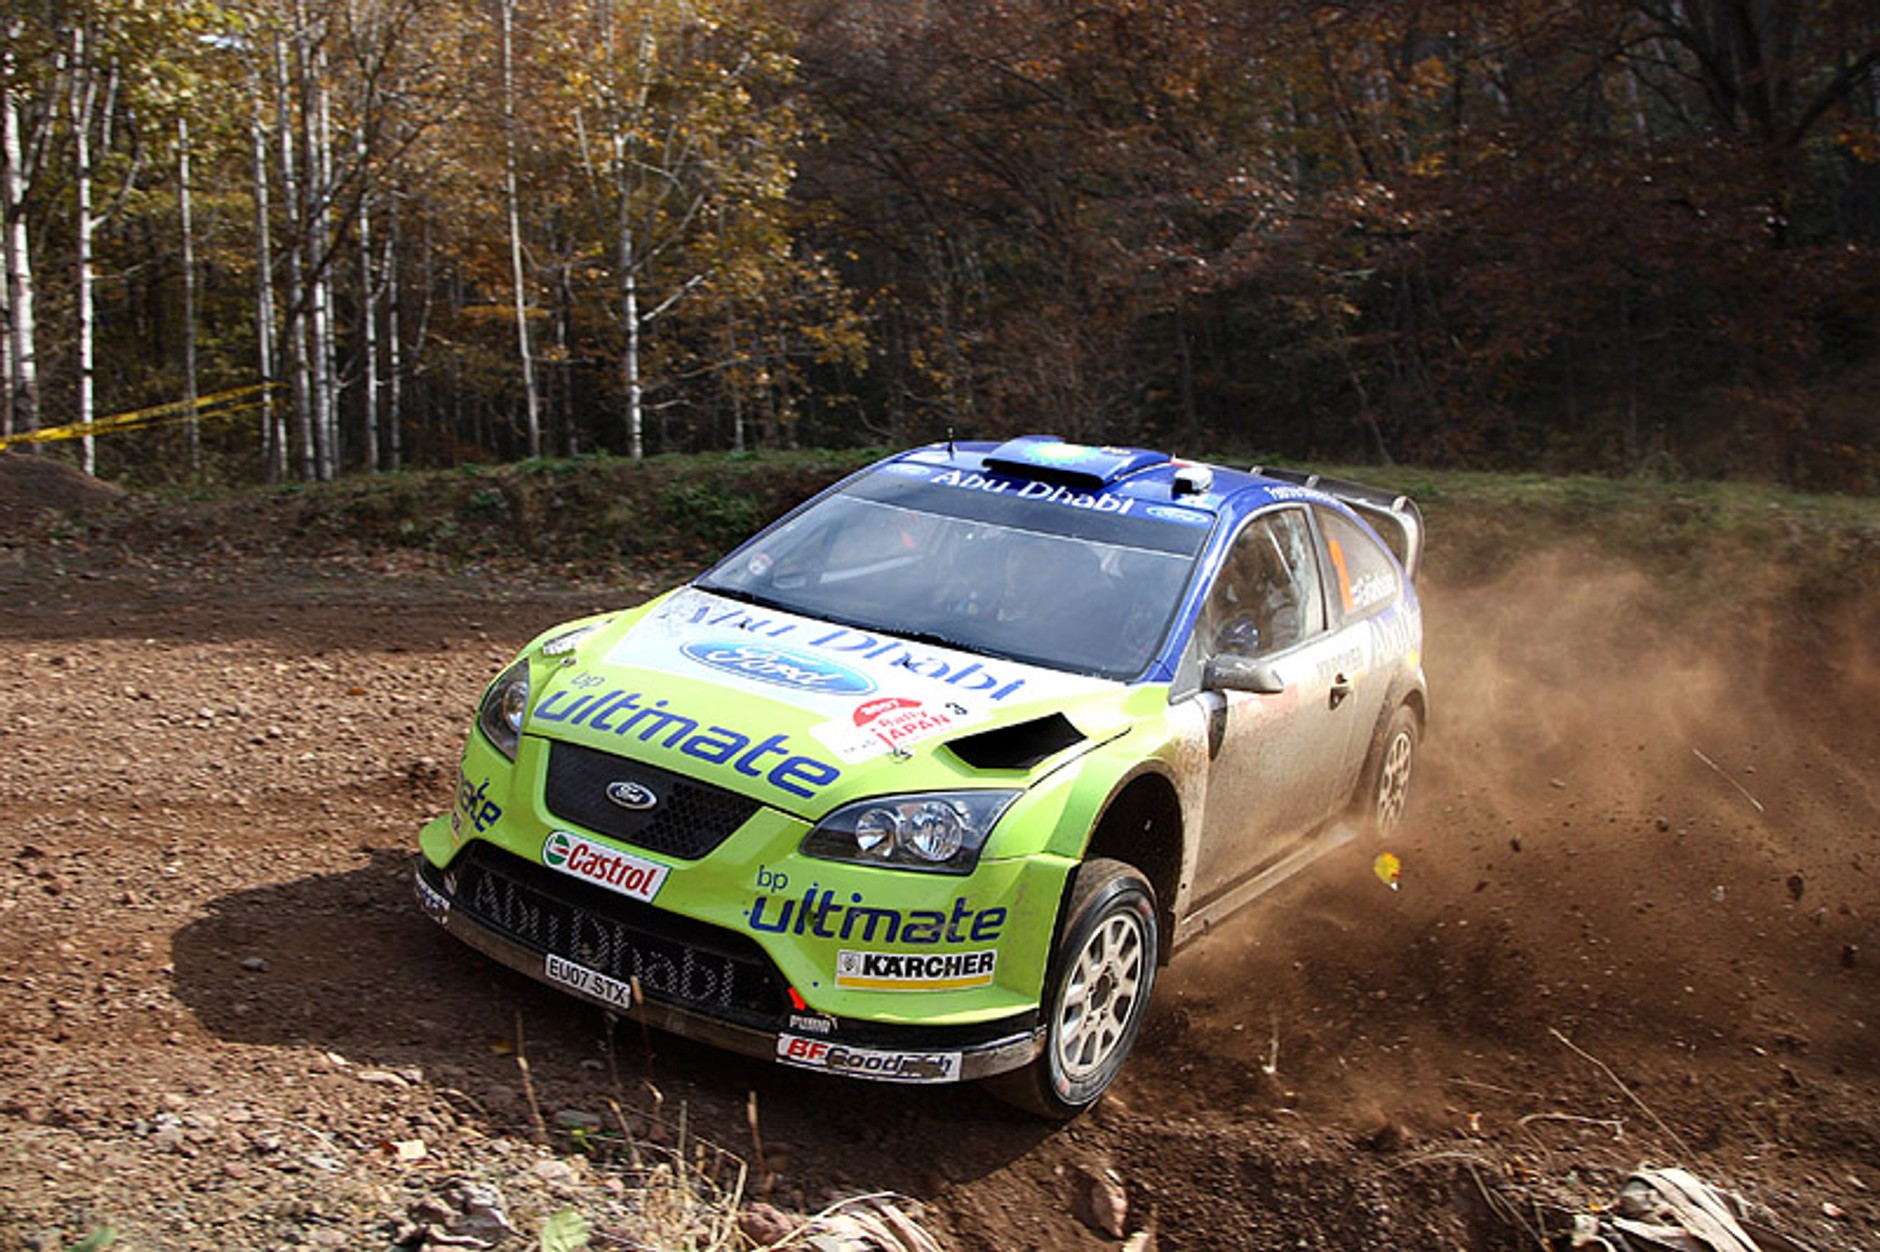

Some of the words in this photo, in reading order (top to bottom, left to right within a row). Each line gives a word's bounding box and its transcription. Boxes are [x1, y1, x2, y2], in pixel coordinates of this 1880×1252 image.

[930, 470, 1011, 493] Abu
[1017, 480, 1136, 515] Dhabi
[706, 647, 844, 686] Ford
[808, 628, 1025, 702] Dhabi
[533, 690, 841, 799] ultimate
[615, 785, 644, 802] Ford
[565, 843, 658, 896] Castrol
[757, 865, 788, 893] bp
[749, 884, 1007, 944] ultimate
[549, 957, 589, 988] EU07
[593, 978, 628, 1005] STX
[569, 907, 736, 1008] Dhabi
[862, 952, 994, 978] KÄRCHER
